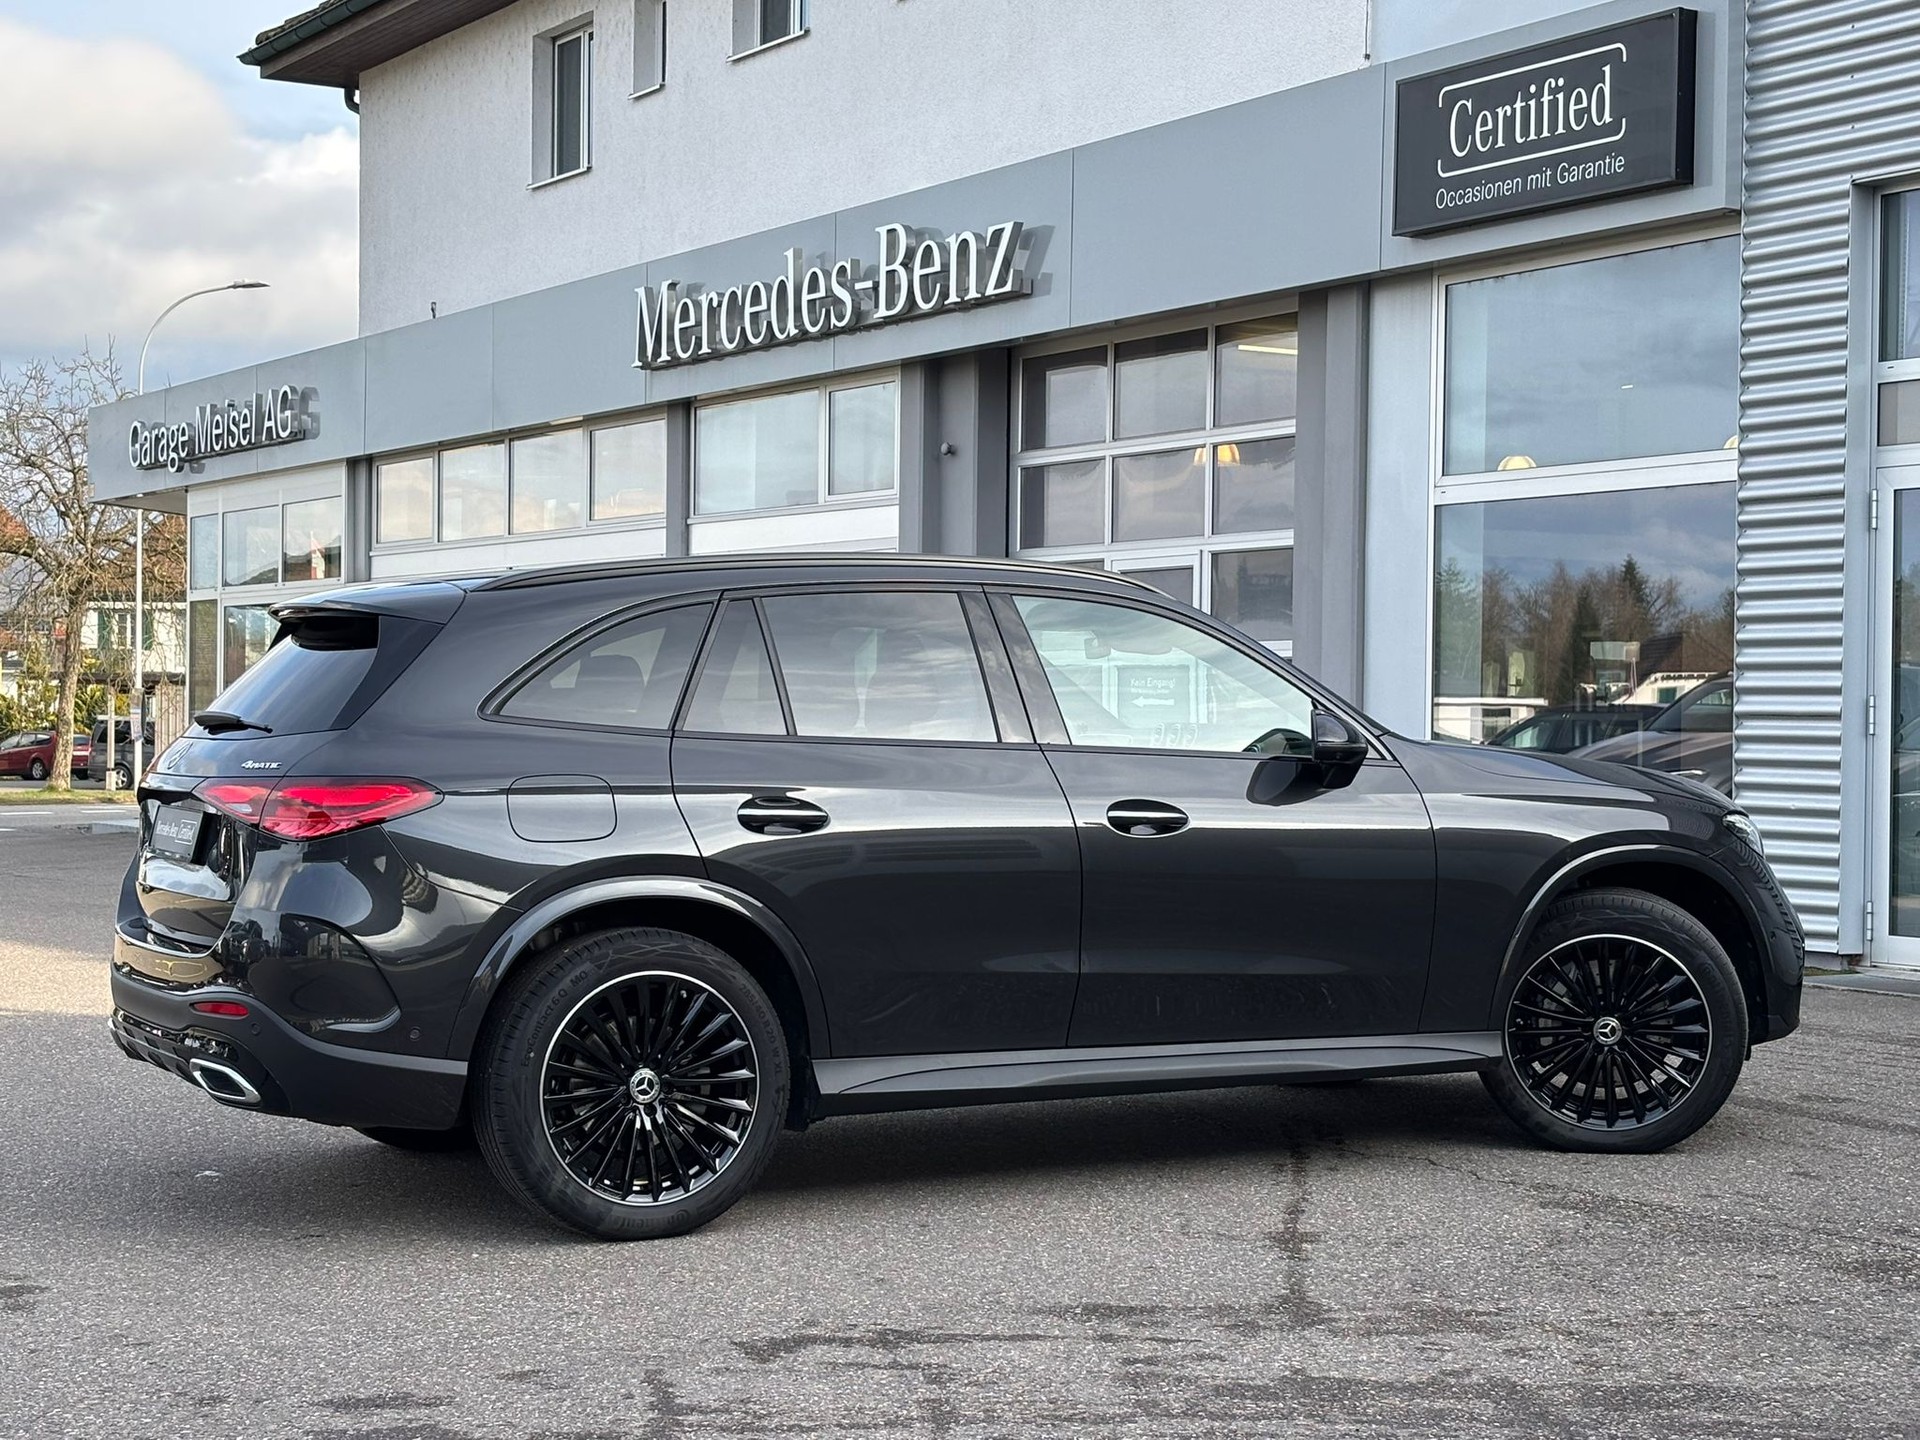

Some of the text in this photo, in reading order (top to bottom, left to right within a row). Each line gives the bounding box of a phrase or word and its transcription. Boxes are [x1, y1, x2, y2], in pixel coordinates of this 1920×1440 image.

[1449, 63, 1613, 158] Certified
[1435, 151, 1625, 210] Occasionen mit Garantie
[632, 220, 1020, 369] Mercedes-Benz
[129, 384, 293, 473] Garage Meisel AG
[241, 760, 282, 770] 4MATIC
